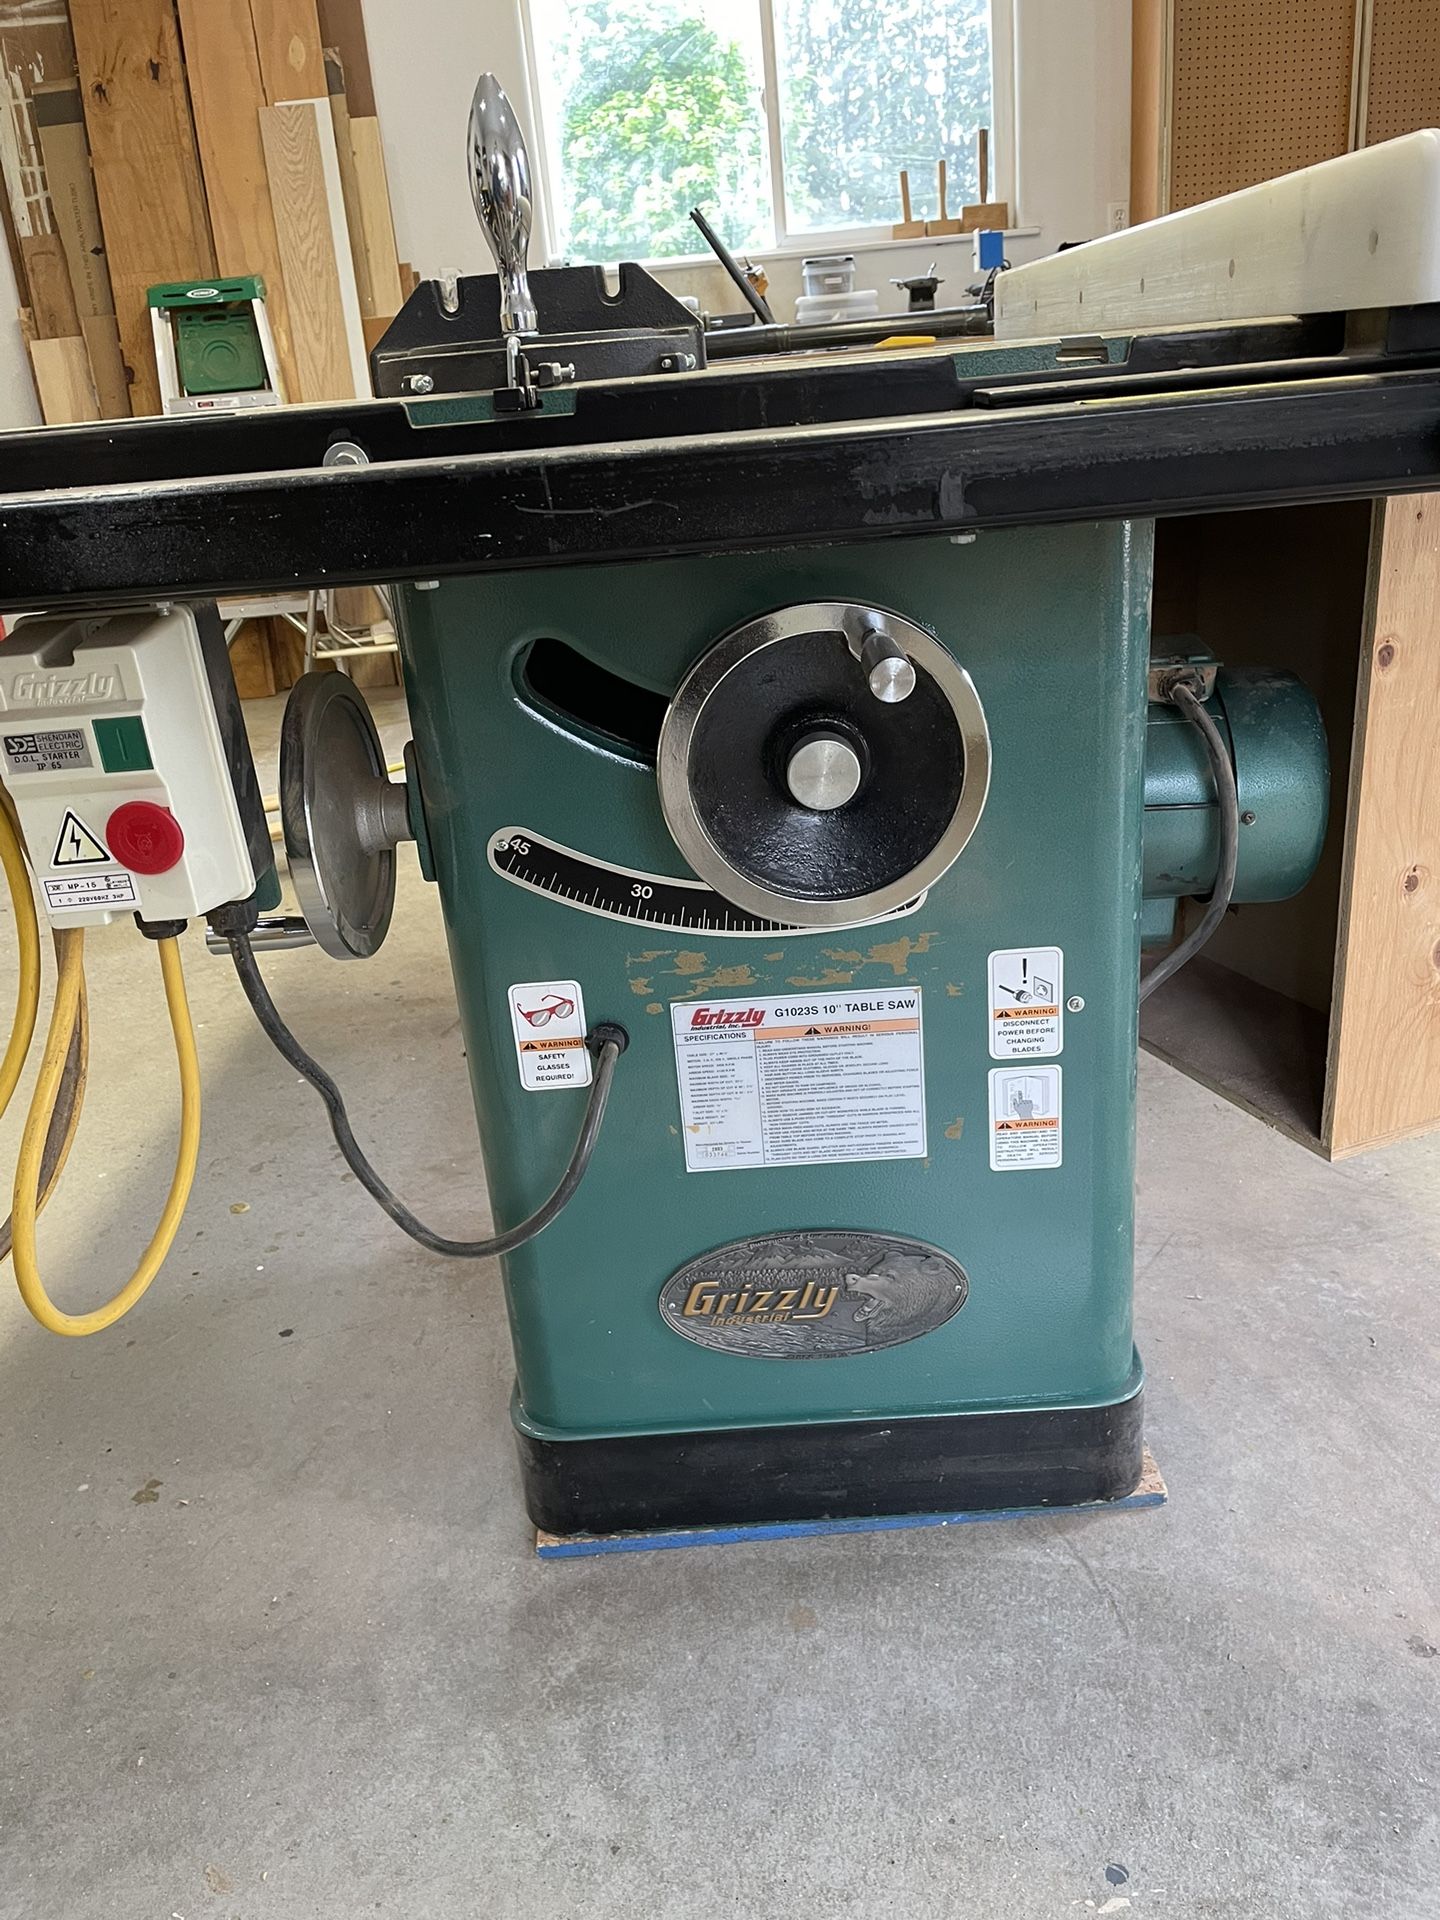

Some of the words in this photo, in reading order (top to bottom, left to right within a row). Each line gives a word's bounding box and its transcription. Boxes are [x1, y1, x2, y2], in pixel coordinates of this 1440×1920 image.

[12, 673, 114, 700] Grizzly
[36, 732, 79, 742] SHENDIAN
[39, 741, 81, 751] ELECTRIC
[42, 751, 80, 761] STARTER
[37, 762, 47, 770] IP
[51, 761, 62, 769] 65
[509, 838, 531, 856] 45
[630, 883, 653, 899] 30
[691, 1008, 766, 1028] Grizzly
[774, 1006, 819, 1017] G1023S
[845, 1001, 884, 1013] TABLE
[888, 1000, 916, 1010] SAW
[1014, 1008, 1057, 1016] WARNING!
[1003, 1019, 1050, 1027] DISCONNECT
[824, 1024, 871, 1033] WARNING!
[998, 1028, 1024, 1036] POWER
[1026, 1027, 1055, 1035] BEFORE
[684, 1032, 747, 1042] SPECIFICATIONS
[1006, 1037, 1045, 1045] CHANGING
[540, 1040, 581, 1048] WARNING!
[538, 1053, 566, 1061] SAFETY
[537, 1063, 570, 1071] GLASSES
[536, 1073, 575, 1081] REQUIRED!
[1015, 1120, 1057, 1128] WARNING!
[683, 1281, 839, 1319] Grizzly
